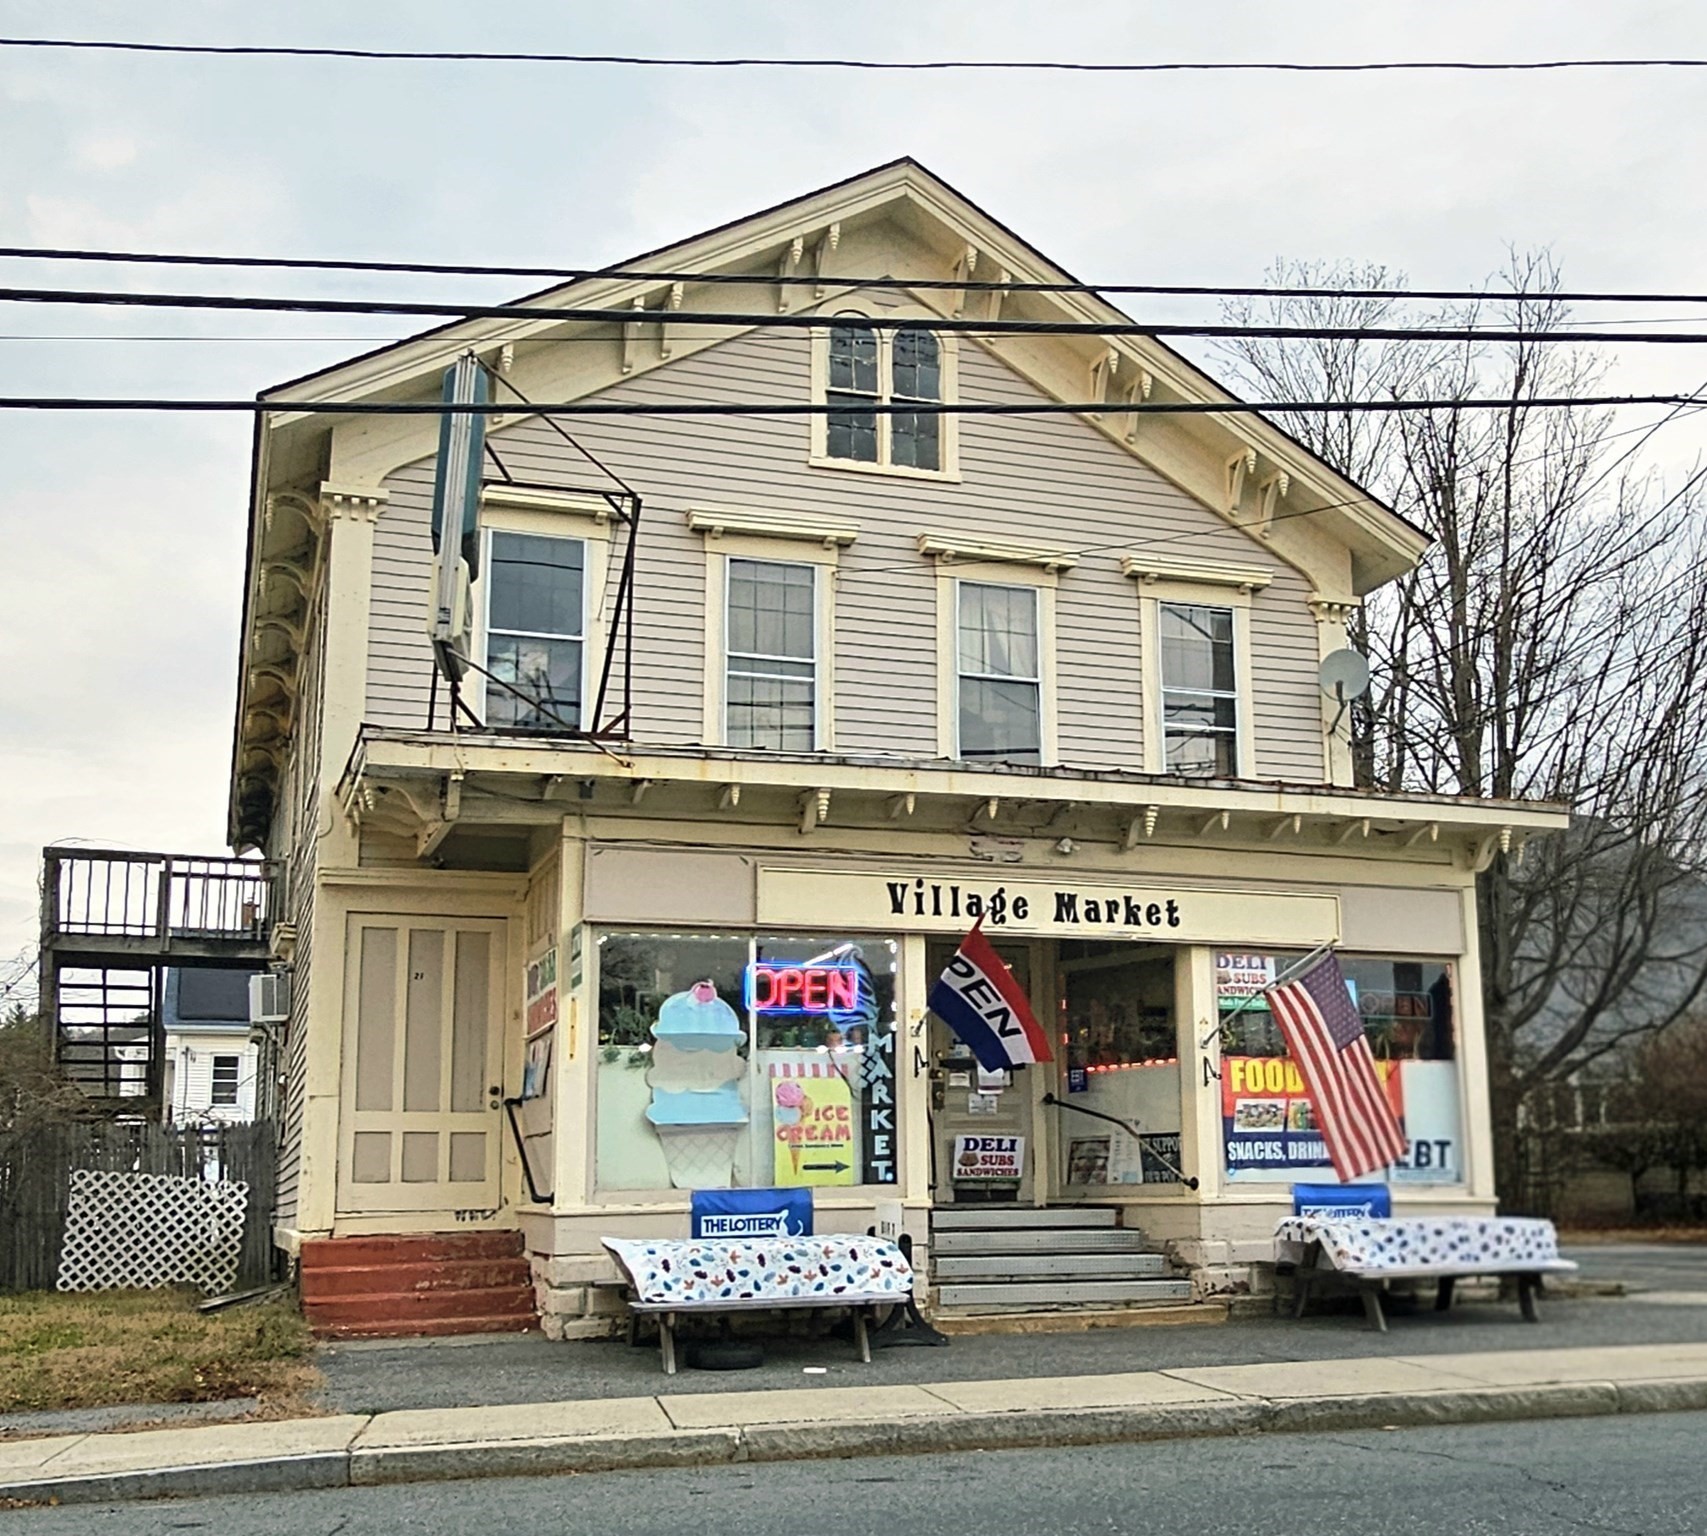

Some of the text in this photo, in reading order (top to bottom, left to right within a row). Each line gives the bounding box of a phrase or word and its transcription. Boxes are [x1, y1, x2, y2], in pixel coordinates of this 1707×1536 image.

[886, 878, 1180, 927] Village Market
[1216, 954, 1267, 969] DELI
[1233, 973, 1267, 984] SUBS
[755, 969, 855, 1009] OPEN
[1230, 1058, 1305, 1092] FOOD
[814, 1105, 849, 1121] ICE
[776, 1125, 851, 1141] CREAM
[963, 1138, 1018, 1152] DELI
[1227, 1141, 1287, 1161] SNACKS,
[980, 1155, 1015, 1166] SUBS
[957, 1168, 1019, 1177] SANDWICHES
